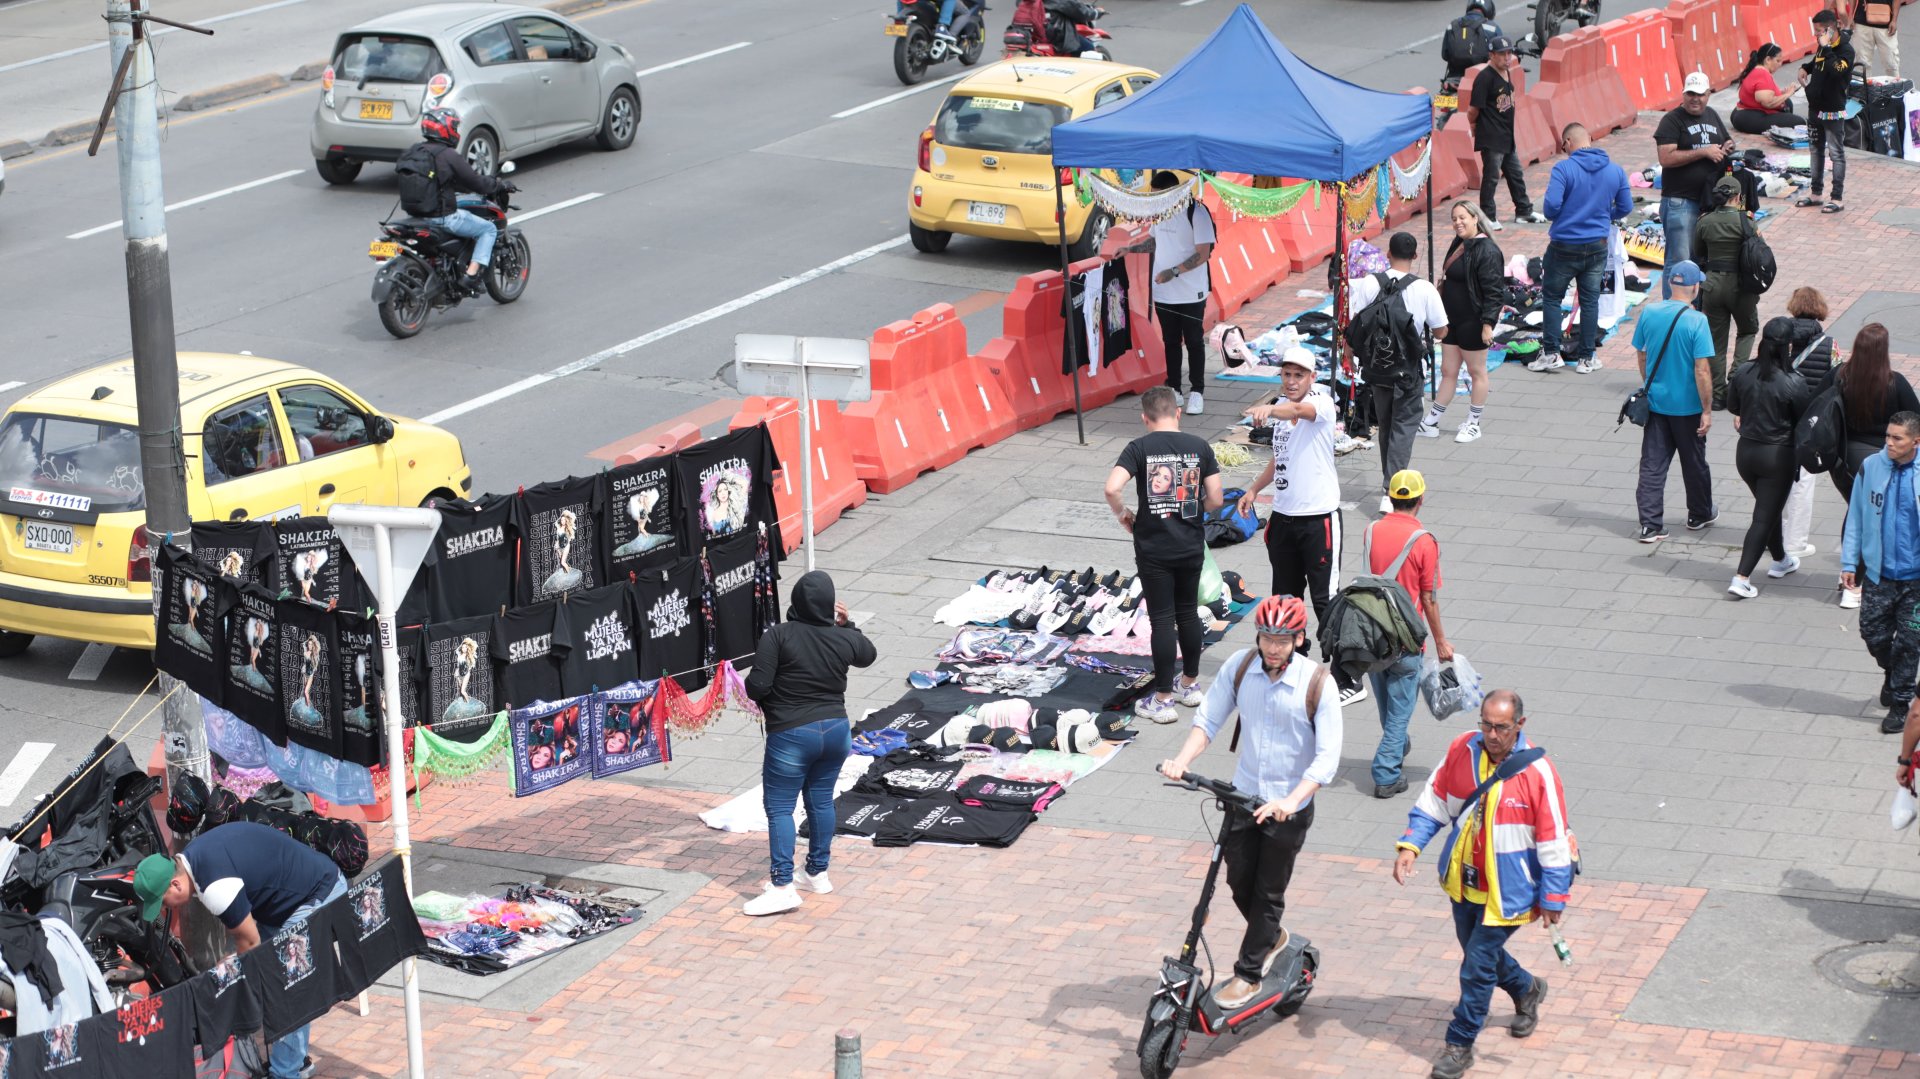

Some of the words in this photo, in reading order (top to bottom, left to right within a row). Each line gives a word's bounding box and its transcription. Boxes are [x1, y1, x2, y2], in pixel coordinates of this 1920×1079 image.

[1687, 124, 1701, 135] NEW
[1701, 123, 1718, 135] YORK
[613, 467, 667, 491] SHAKIRA
[699, 456, 750, 485] SHAKIRA
[279, 528, 339, 545] SHAKIRA
[446, 525, 504, 555] SHAKIRA
[88, 575, 118, 586] 35507
[647, 596, 689, 621] MUJERES
[658, 590, 679, 608] LAS
[595, 612, 617, 628] LAS
[650, 614, 691, 639] LLORAN
[653, 615, 668, 628] YA
[669, 608, 686, 621] NO
[586, 639, 632, 661] LLORAN
[590, 638, 606, 649] YA
[606, 631, 625, 645] NO
[581, 699, 589, 752] SHAKIRA
[594, 702, 603, 756] SHAKIRA
[516, 722, 528, 775] SHAKIRA
[605, 748, 650, 767] SHAKIRA
[531, 760, 580, 784] SHAKIRA
[347, 871, 382, 899] SHAKIRA
[272, 918, 309, 947] SHAKIRA
[117, 995, 164, 1022] MUJERES
[123, 1016, 139, 1031] YA
[140, 1009, 158, 1024] NO
[118, 1017, 165, 1044] LLORAN
